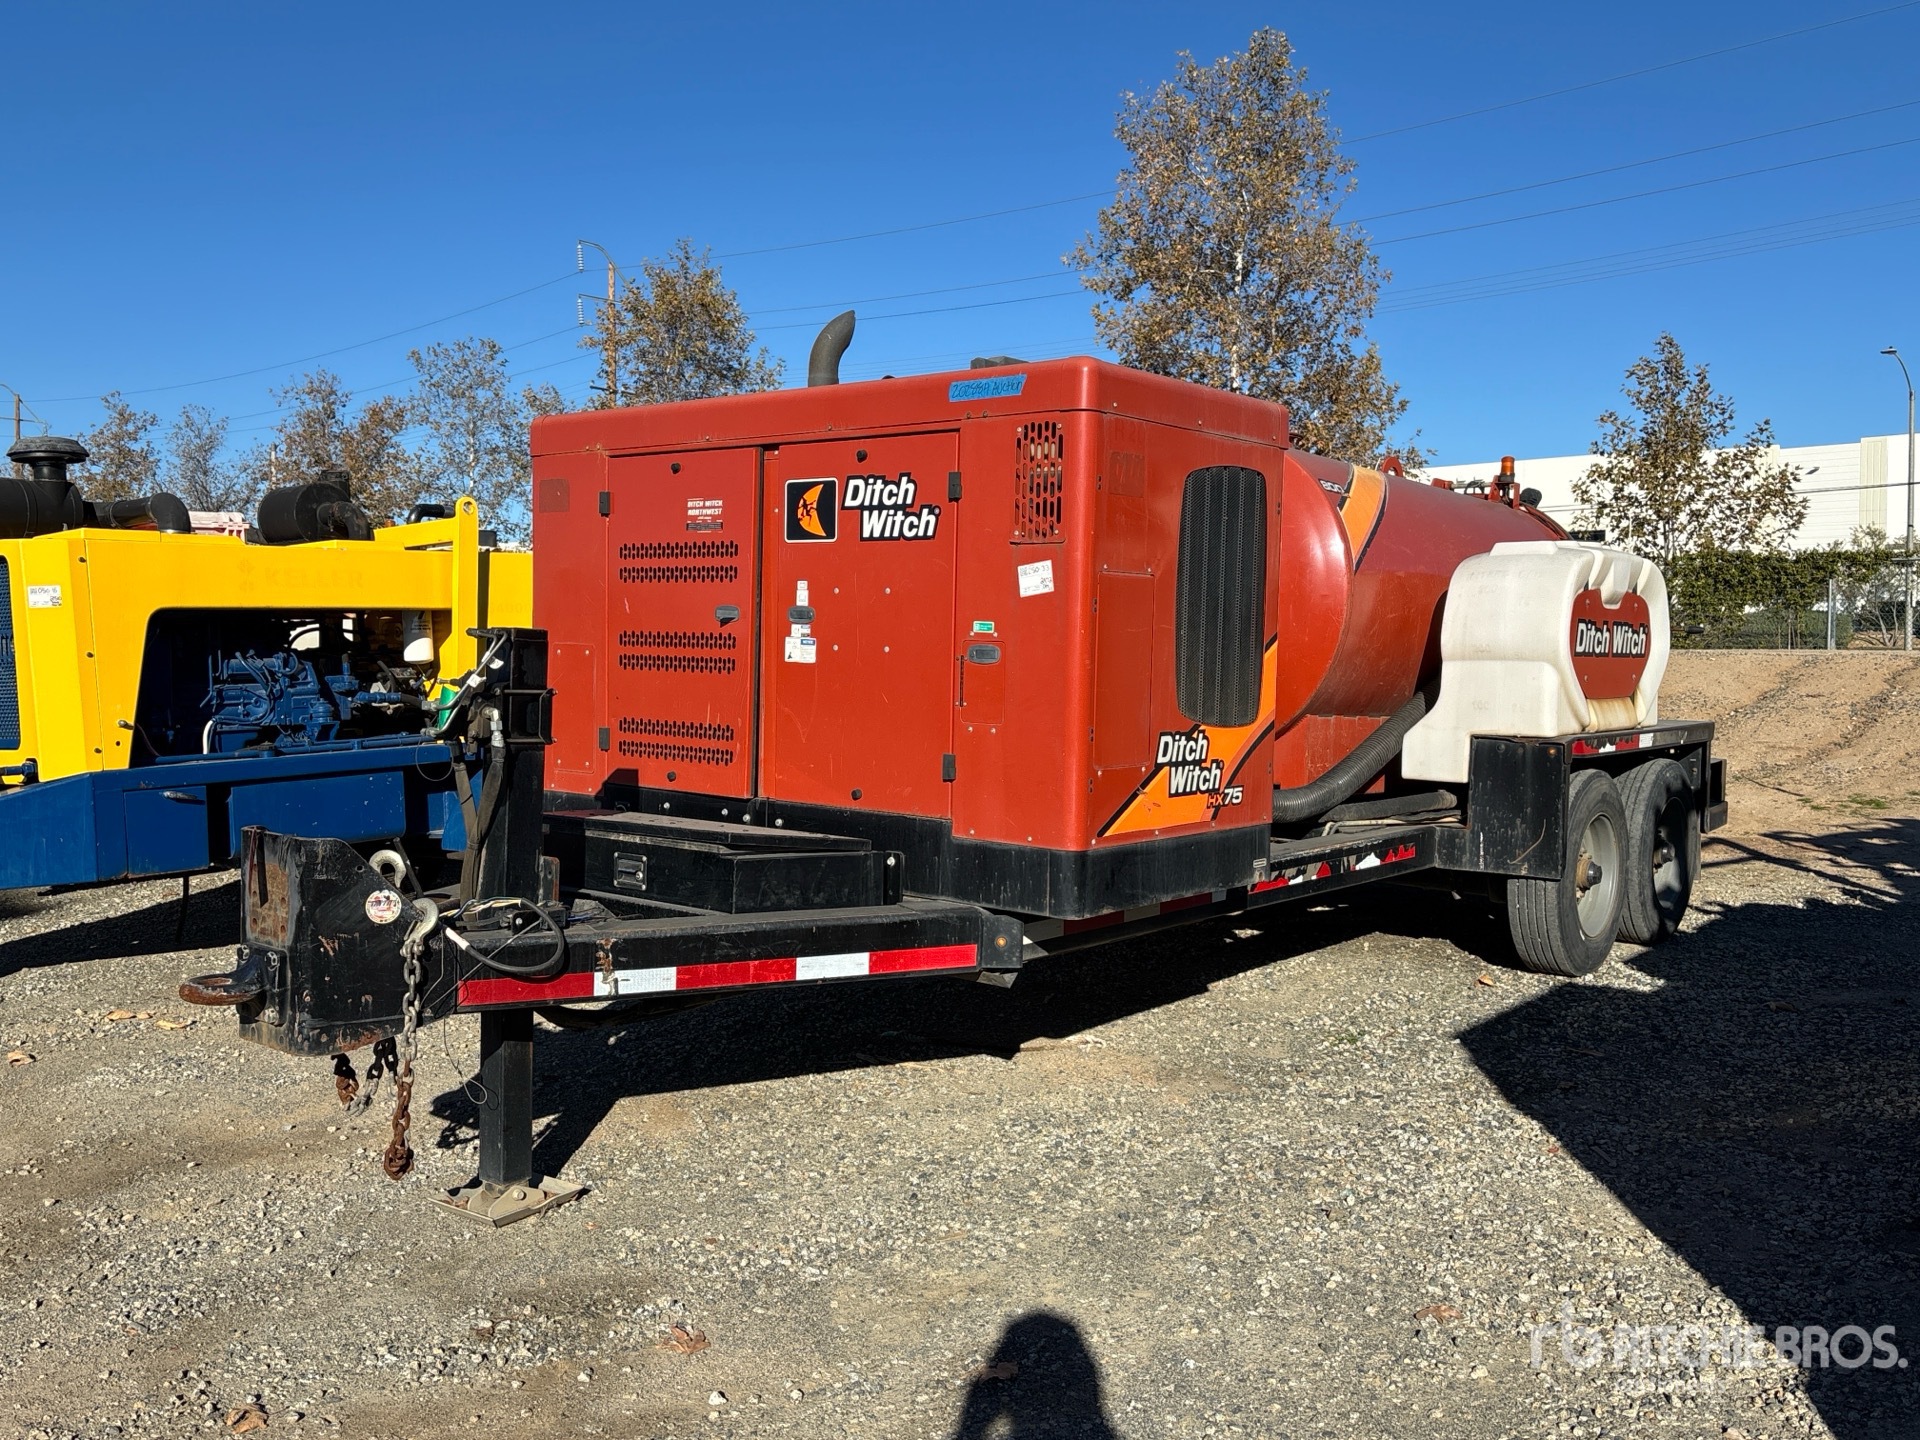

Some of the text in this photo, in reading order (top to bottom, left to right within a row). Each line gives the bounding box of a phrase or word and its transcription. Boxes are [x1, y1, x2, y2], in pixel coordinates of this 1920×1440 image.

[844, 476, 915, 507] Ditch
[862, 508, 936, 538] Witch
[1575, 622, 1646, 655] Ditch Witch
[1156, 732, 1209, 764] Ditch
[1170, 762, 1221, 794] Witch
[1208, 786, 1243, 807] HX75
